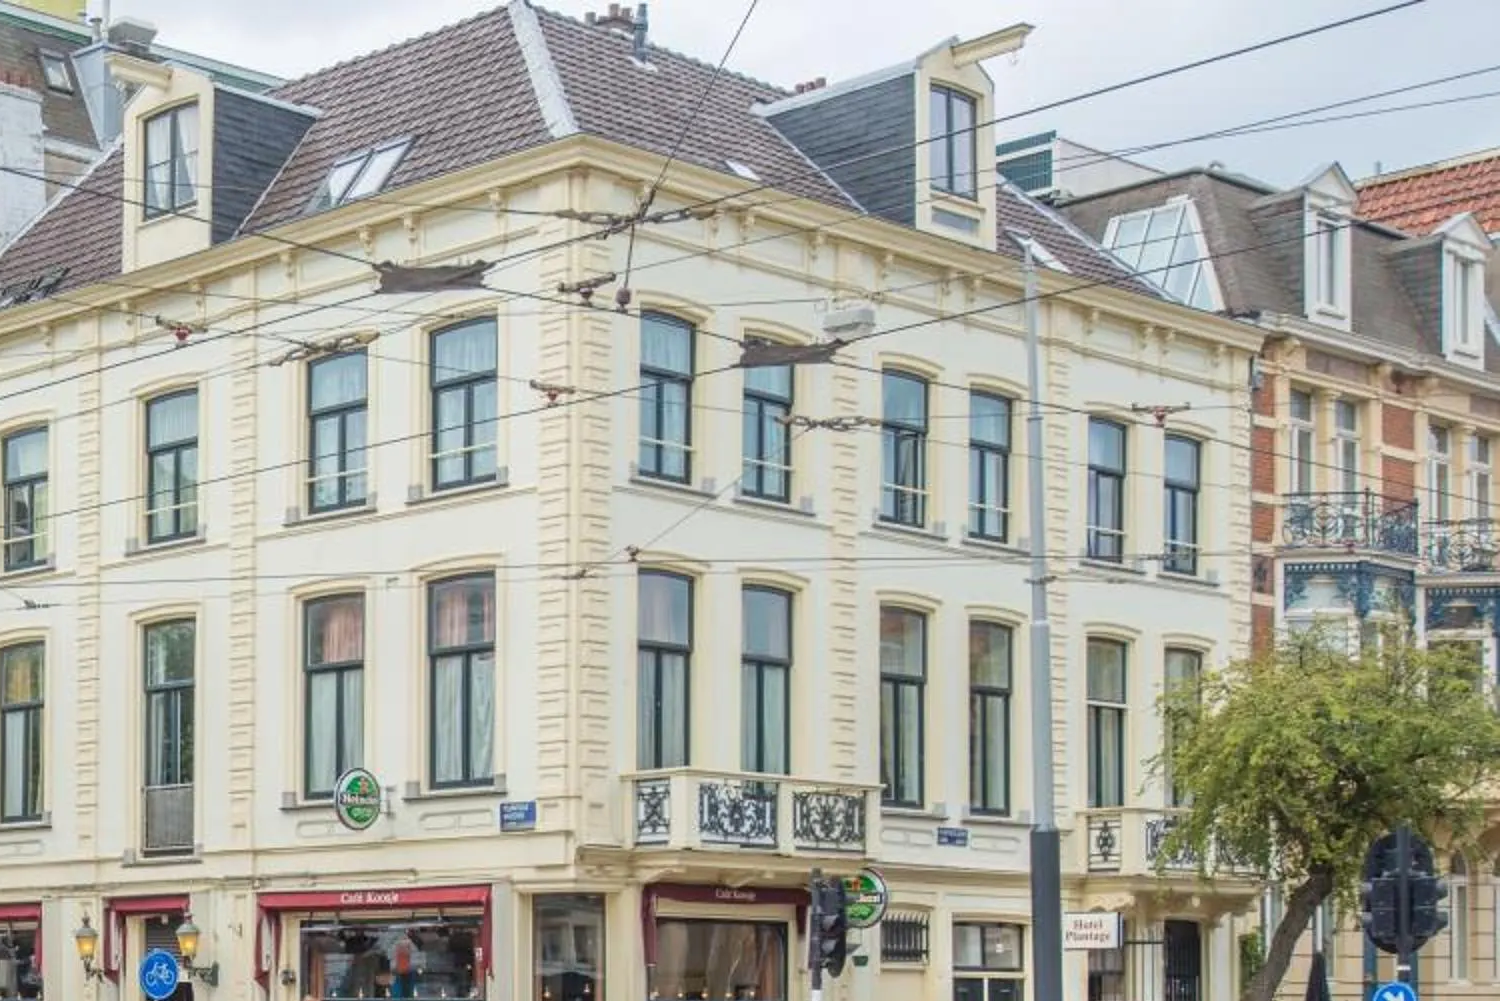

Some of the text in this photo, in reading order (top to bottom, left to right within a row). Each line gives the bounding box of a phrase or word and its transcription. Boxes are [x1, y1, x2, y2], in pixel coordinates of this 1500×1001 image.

[340, 891, 363, 904] Café
[1073, 919, 1103, 930] Hotel
[1065, 931, 1111, 943] Plantage
